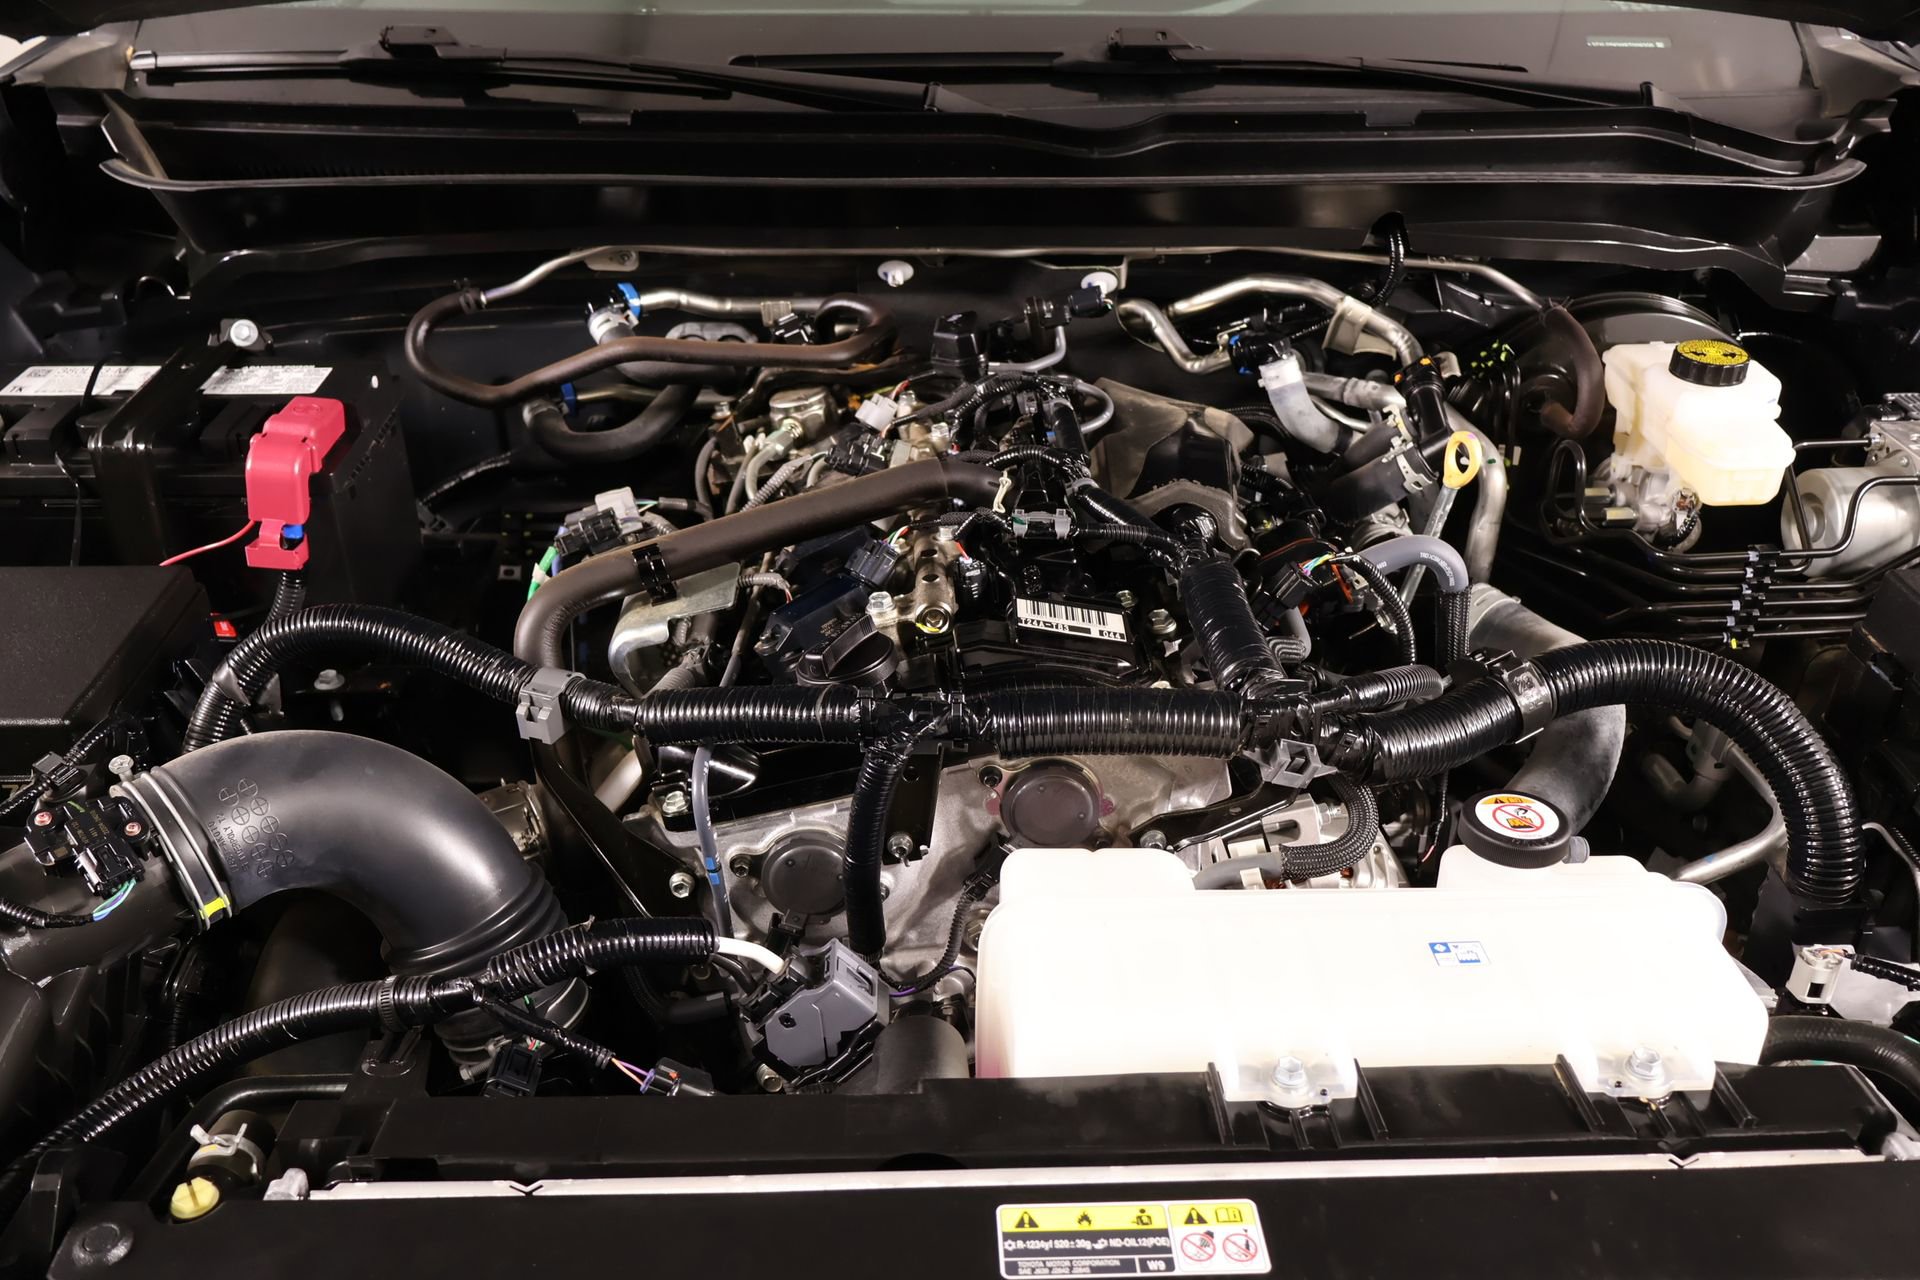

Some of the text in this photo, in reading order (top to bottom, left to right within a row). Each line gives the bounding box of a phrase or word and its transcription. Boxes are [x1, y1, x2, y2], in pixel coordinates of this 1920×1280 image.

[1016, 1239, 1053, 1251] R-1234yf
[1017, 1258, 1120, 1268] TOYOTA MOTOR CORPORATION
[1146, 1259, 1167, 1271] W9
